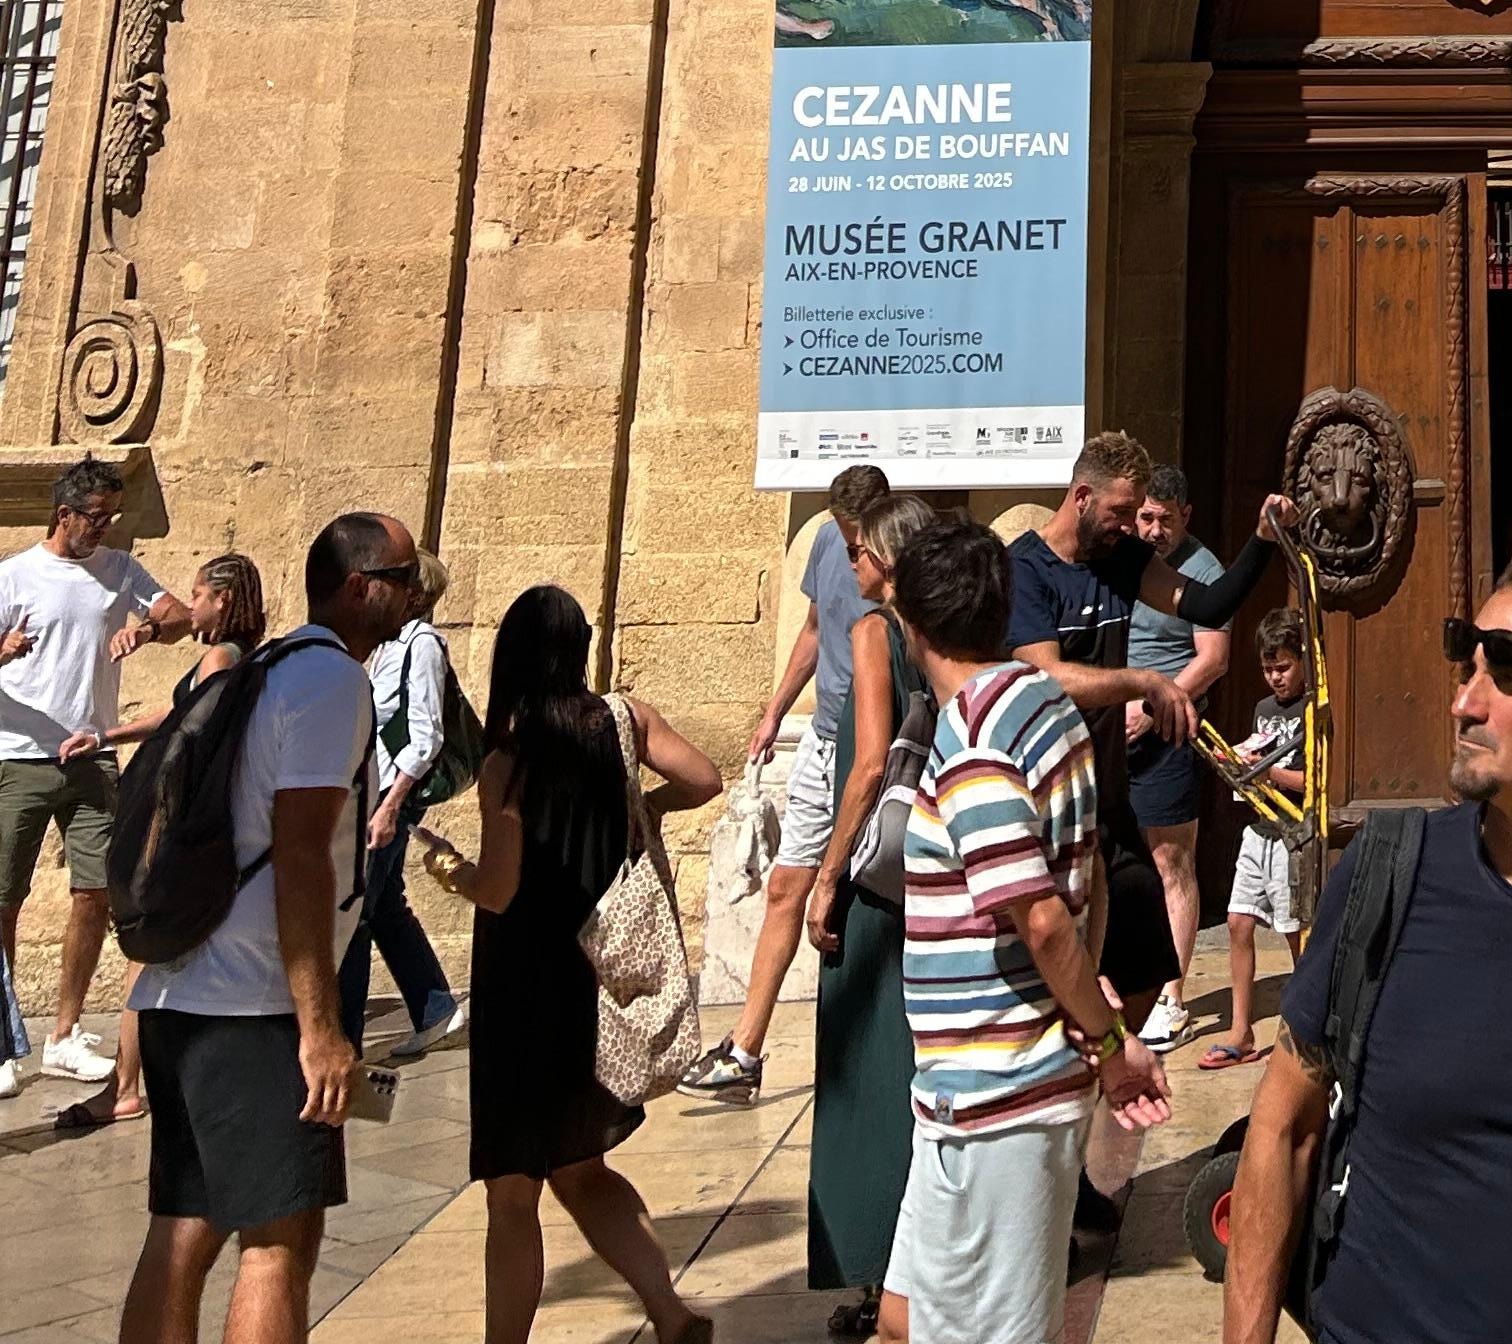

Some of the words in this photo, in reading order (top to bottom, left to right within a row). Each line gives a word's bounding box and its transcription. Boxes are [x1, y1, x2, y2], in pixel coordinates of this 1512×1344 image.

[793, 82, 1012, 129] CEZANNE
[789, 137, 830, 163] AU
[836, 135, 887, 162] JAS
[894, 135, 931, 161] DE
[938, 131, 1069, 160] BOUFFAN
[788, 175, 809, 193] 28
[811, 175, 852, 192] JUIN
[867, 175, 886, 192] 12
[888, 172, 969, 192] OCTOBRE
[973, 171, 1013, 190] 2025
[785, 215, 907, 256] MUSÉE
[919, 218, 1067, 254] GRANET
[784, 259, 978, 282] AIX-EN-PROVENCE
[783, 305, 855, 323] Billetterie
[858, 303, 925, 321] exclusive
[800, 327, 859, 350] Office
[864, 327, 890, 348] de
[895, 327, 983, 348] Tourisme
[799, 352, 1003, 377] CEZANNE2025.COM
